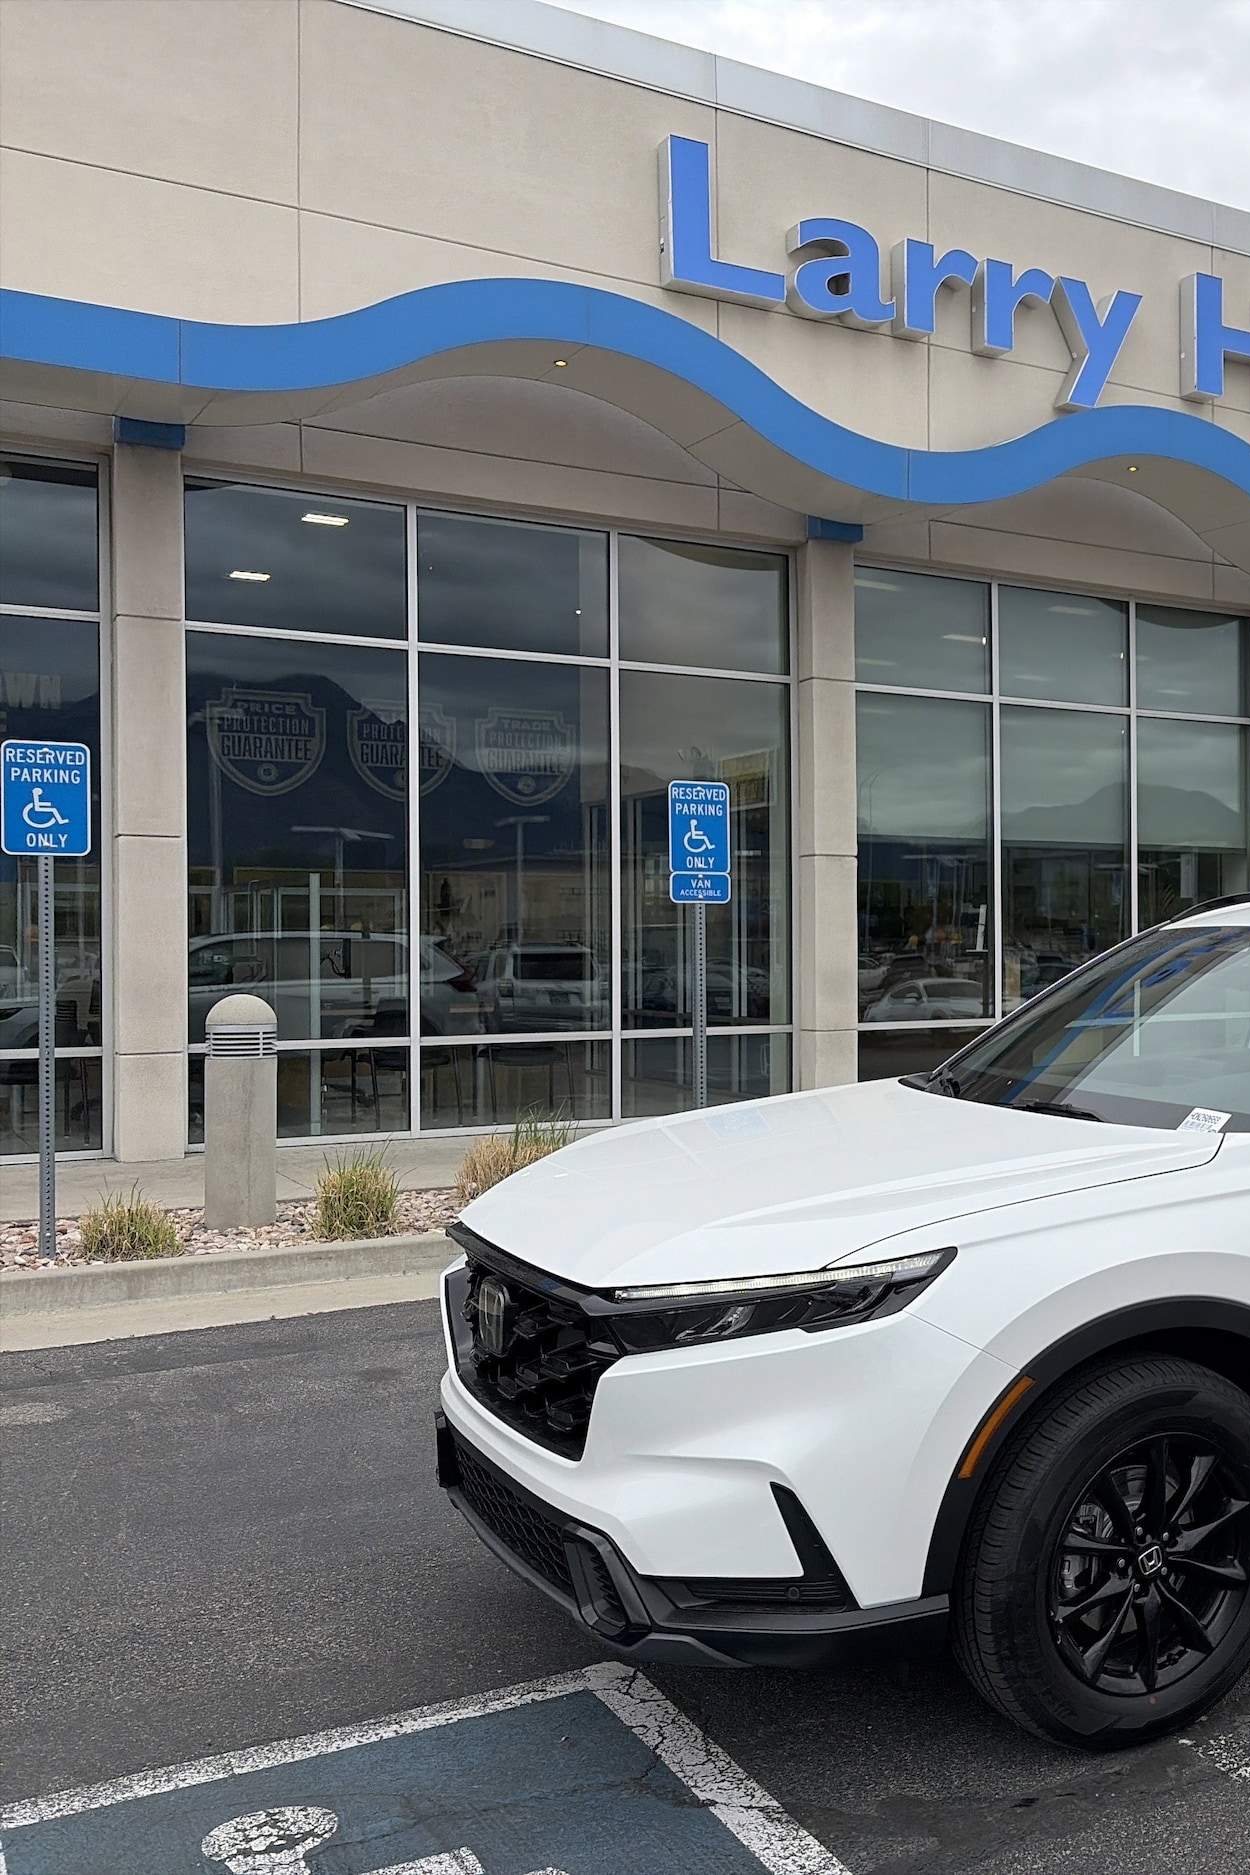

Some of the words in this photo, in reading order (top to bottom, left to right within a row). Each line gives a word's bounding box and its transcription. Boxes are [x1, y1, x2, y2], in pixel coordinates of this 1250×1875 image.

[662, 134, 1144, 410] Larry
[236, 701, 297, 715] PRICE
[222, 714, 310, 735] PROTECTION
[502, 719, 551, 731] TRADE
[362, 723, 442, 744] PROTEON
[490, 730, 563, 749] PROTECTION
[221, 733, 313, 761] GUARANTEE
[360, 743, 444, 768] GUARATEE
[5, 747, 85, 766] RESERVED
[487, 748, 567, 775] GUARANTEE
[10, 767, 81, 784] PARKING
[671, 787, 726, 801] RESERVED
[675, 803, 723, 817] PARKING
[26, 832, 68, 849] ONLY
[686, 856, 715, 869] ONLY
[690, 879, 712, 889] VAN
[680, 889, 721, 897] ACCESSIBLE
